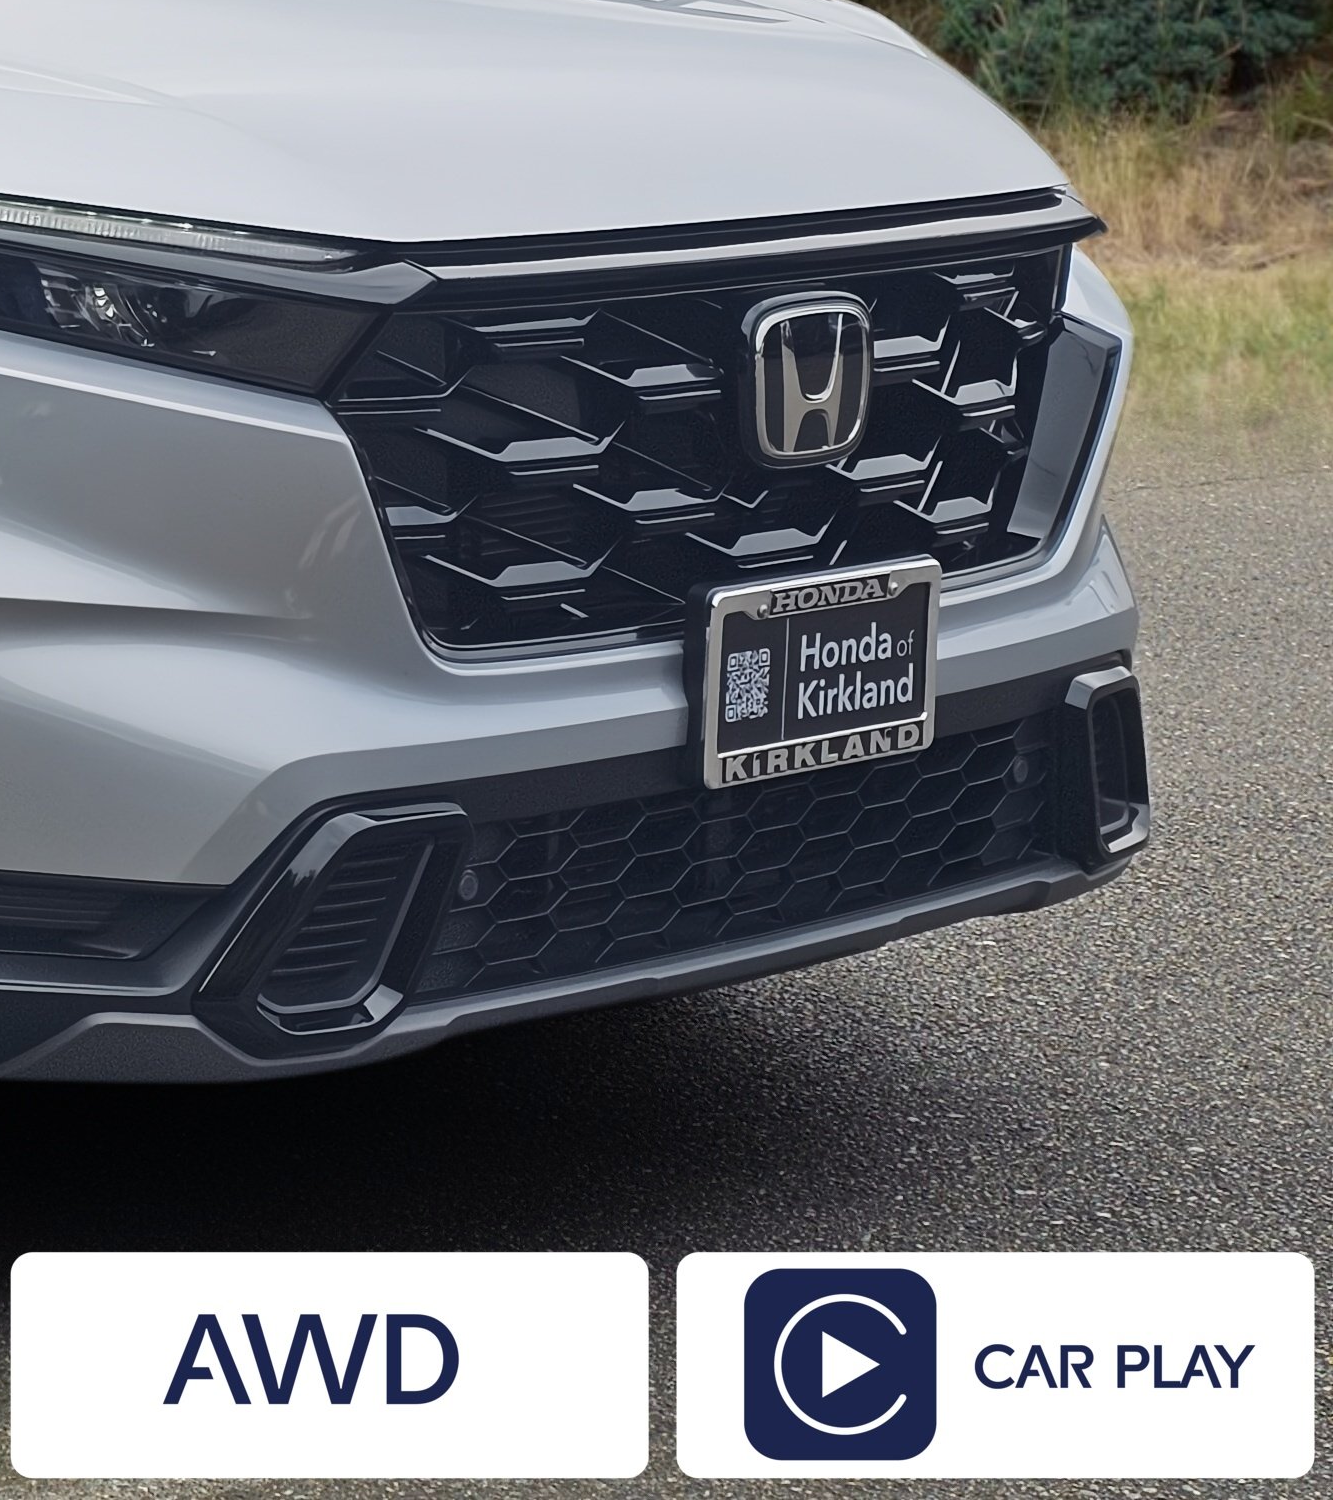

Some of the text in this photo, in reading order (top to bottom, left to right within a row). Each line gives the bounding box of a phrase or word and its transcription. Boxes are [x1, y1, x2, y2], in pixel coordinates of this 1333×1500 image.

[771, 578, 885, 614] HONDA
[799, 621, 915, 673] Honda of
[797, 662, 914, 720] Kirkland
[724, 723, 921, 782] KIRKLAND
